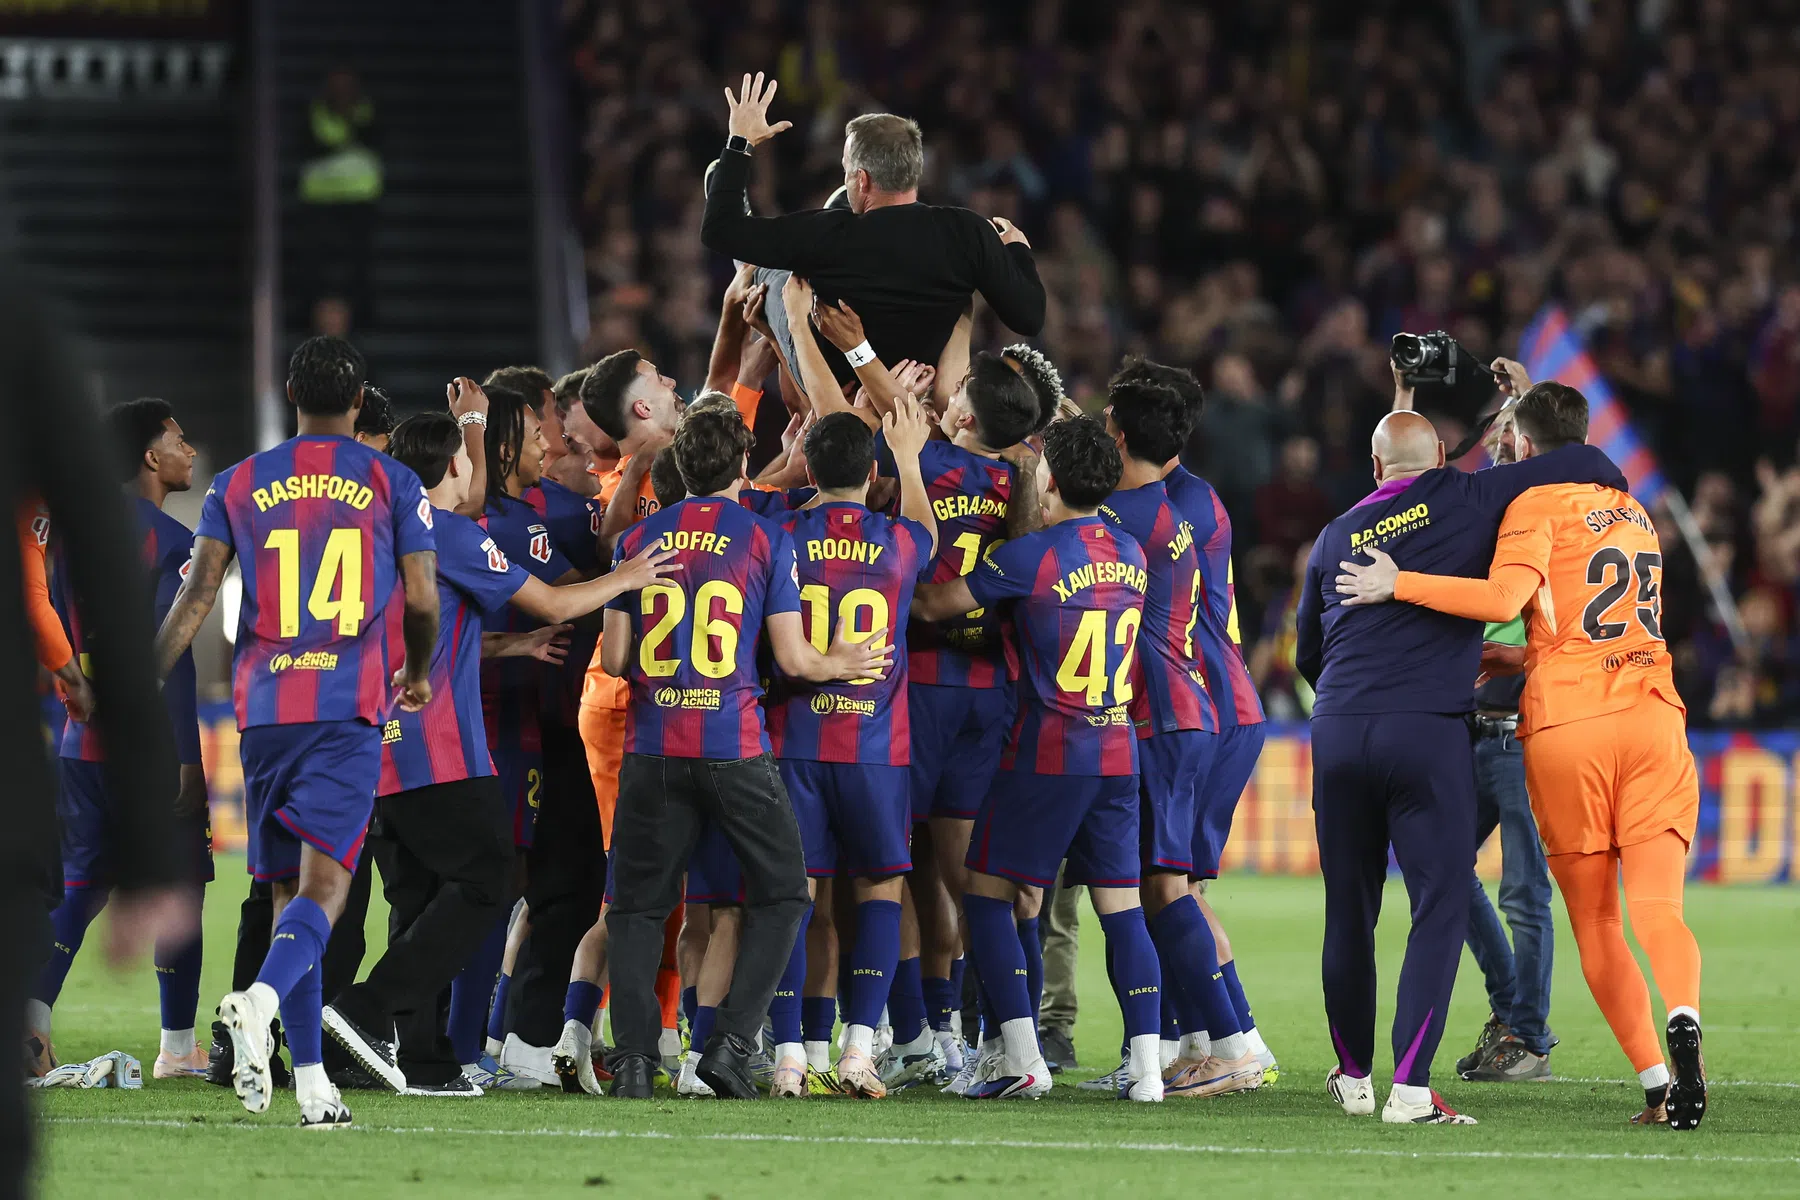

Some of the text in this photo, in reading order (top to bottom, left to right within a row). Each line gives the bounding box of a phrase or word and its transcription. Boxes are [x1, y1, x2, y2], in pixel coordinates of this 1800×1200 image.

[252, 474, 374, 513] RASHFORD
[1350, 503, 1429, 548] R.D. CONGO
[1382, 517, 1431, 543] D'AFRIQUE
[660, 530, 732, 557] JOFRE
[806, 538, 884, 566] ROONY
[263, 528, 365, 638] 14
[1095, 561, 1148, 596] ESPAR
[1582, 546, 1664, 642] 25
[639, 577, 744, 679] 26
[1055, 607, 1141, 707] 42
[681, 697, 720, 707] ACNUR
[682, 688, 721, 698] UNHCR
[836, 701, 875, 714] ACNUR
